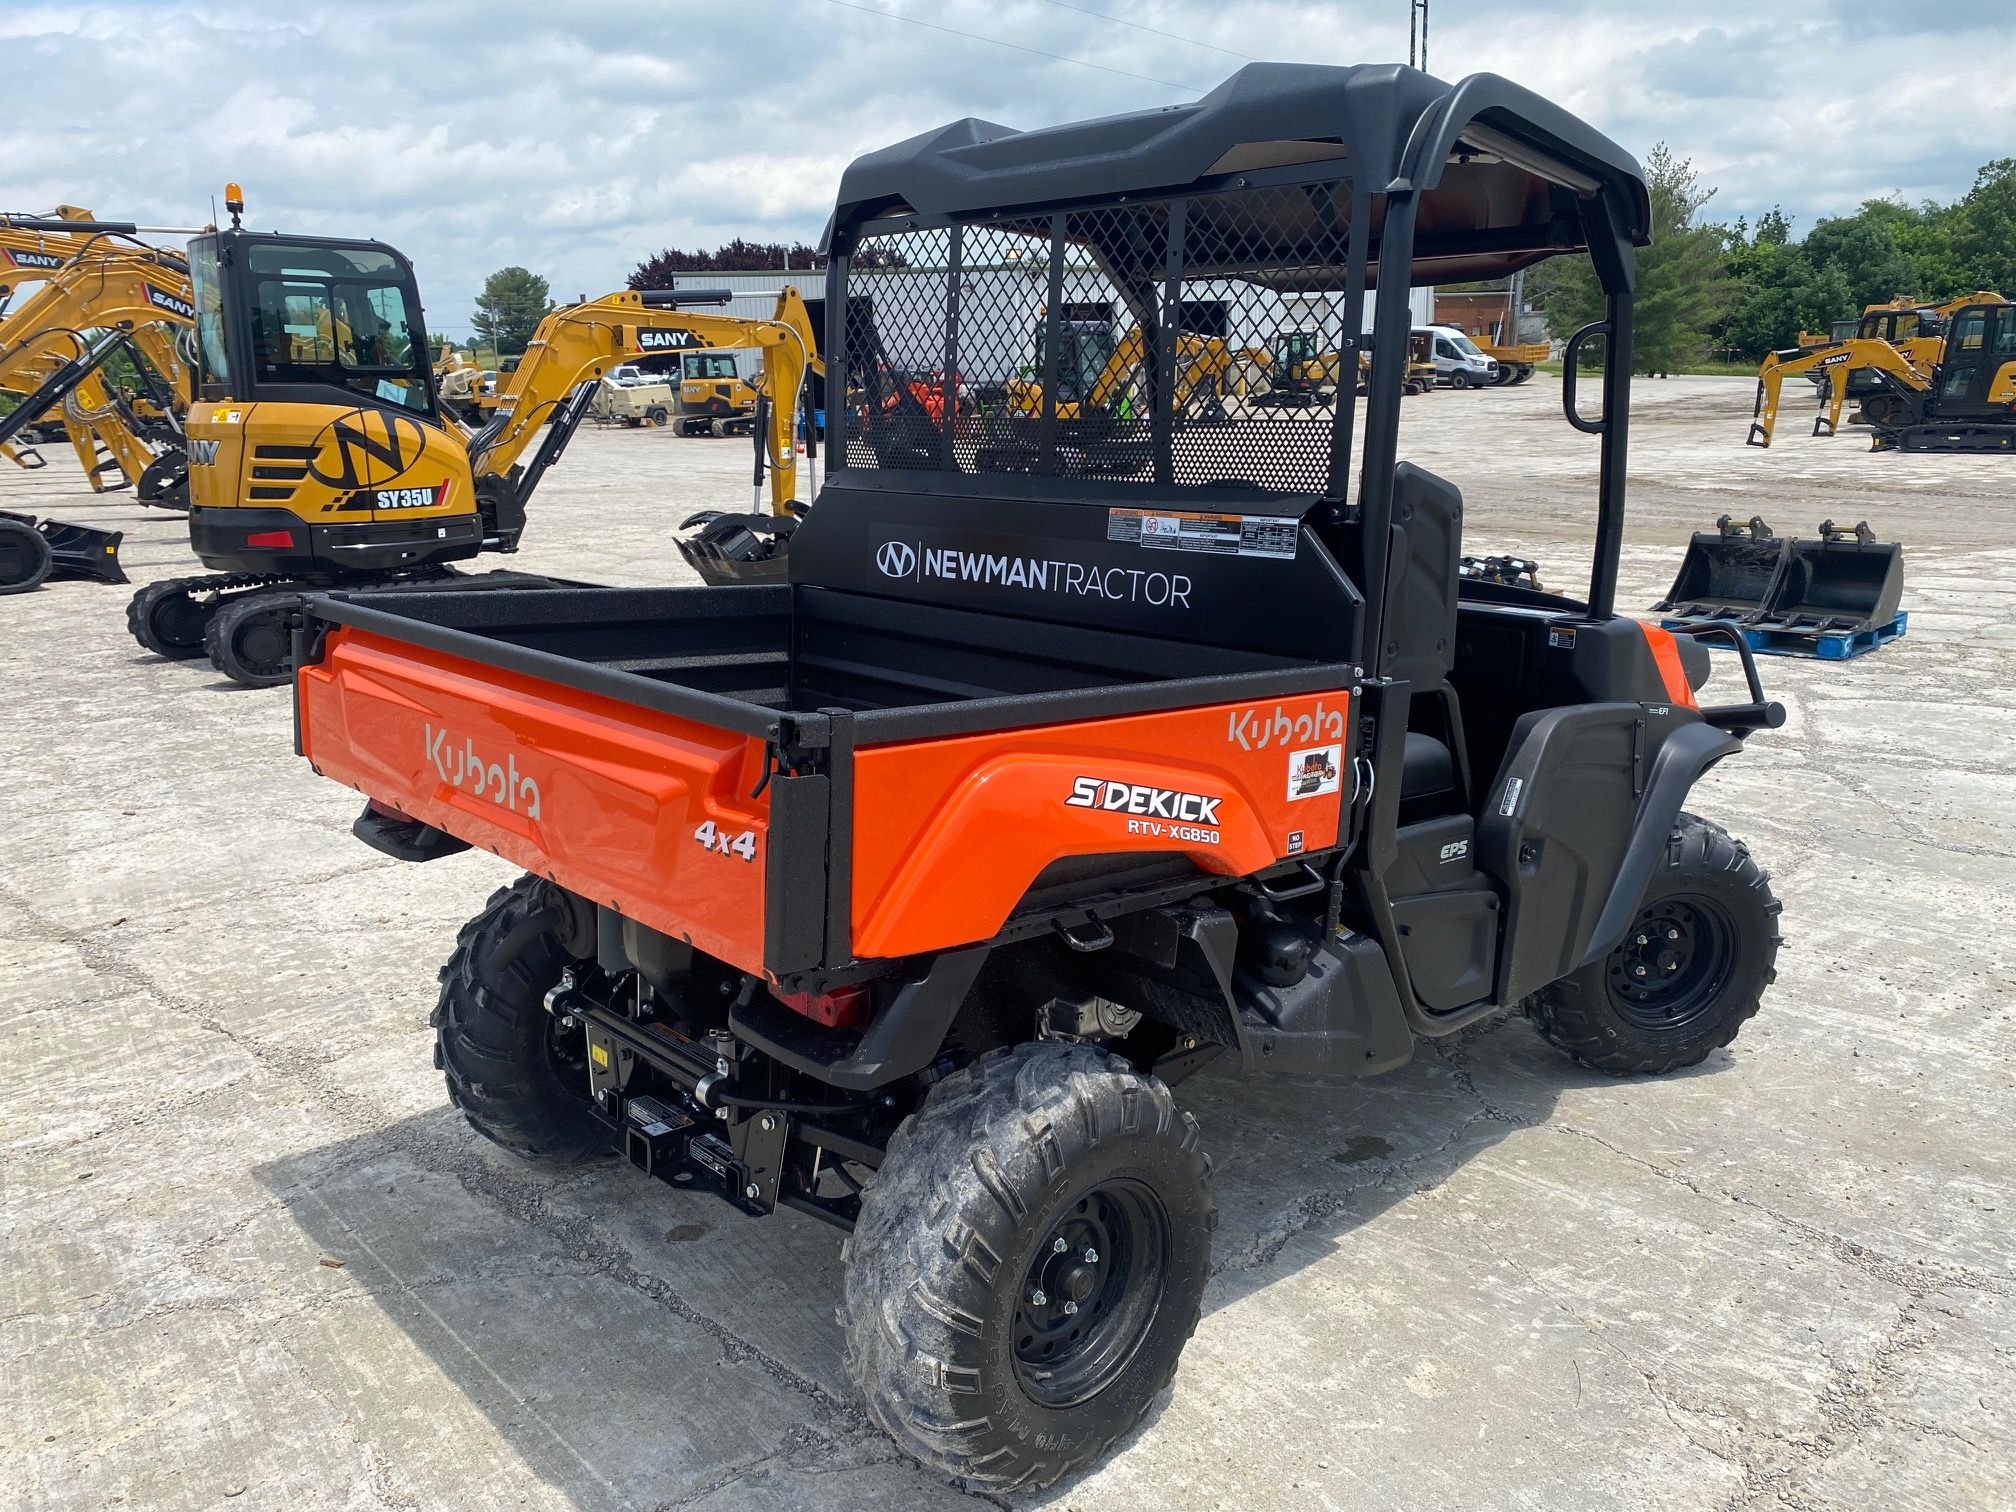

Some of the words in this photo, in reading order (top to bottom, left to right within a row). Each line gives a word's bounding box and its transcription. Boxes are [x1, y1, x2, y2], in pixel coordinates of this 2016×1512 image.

[16, 253, 58, 267] SANY
[152, 292, 194, 317] SANY
[641, 332, 689, 346] SANY
[1824, 354, 1849, 365] SANY
[377, 488, 433, 509] SY35U
[1228, 702, 1343, 750] Kubota
[425, 723, 541, 820] Kubota
[1065, 776, 1222, 826] SIDEKICK
[694, 820, 756, 860] 4x4
[1128, 820, 1220, 845] RTV-XG850
[1292, 834, 1300, 842] NO
[1289, 841, 1302, 850] STEP
[1440, 840, 1468, 859] EPS
